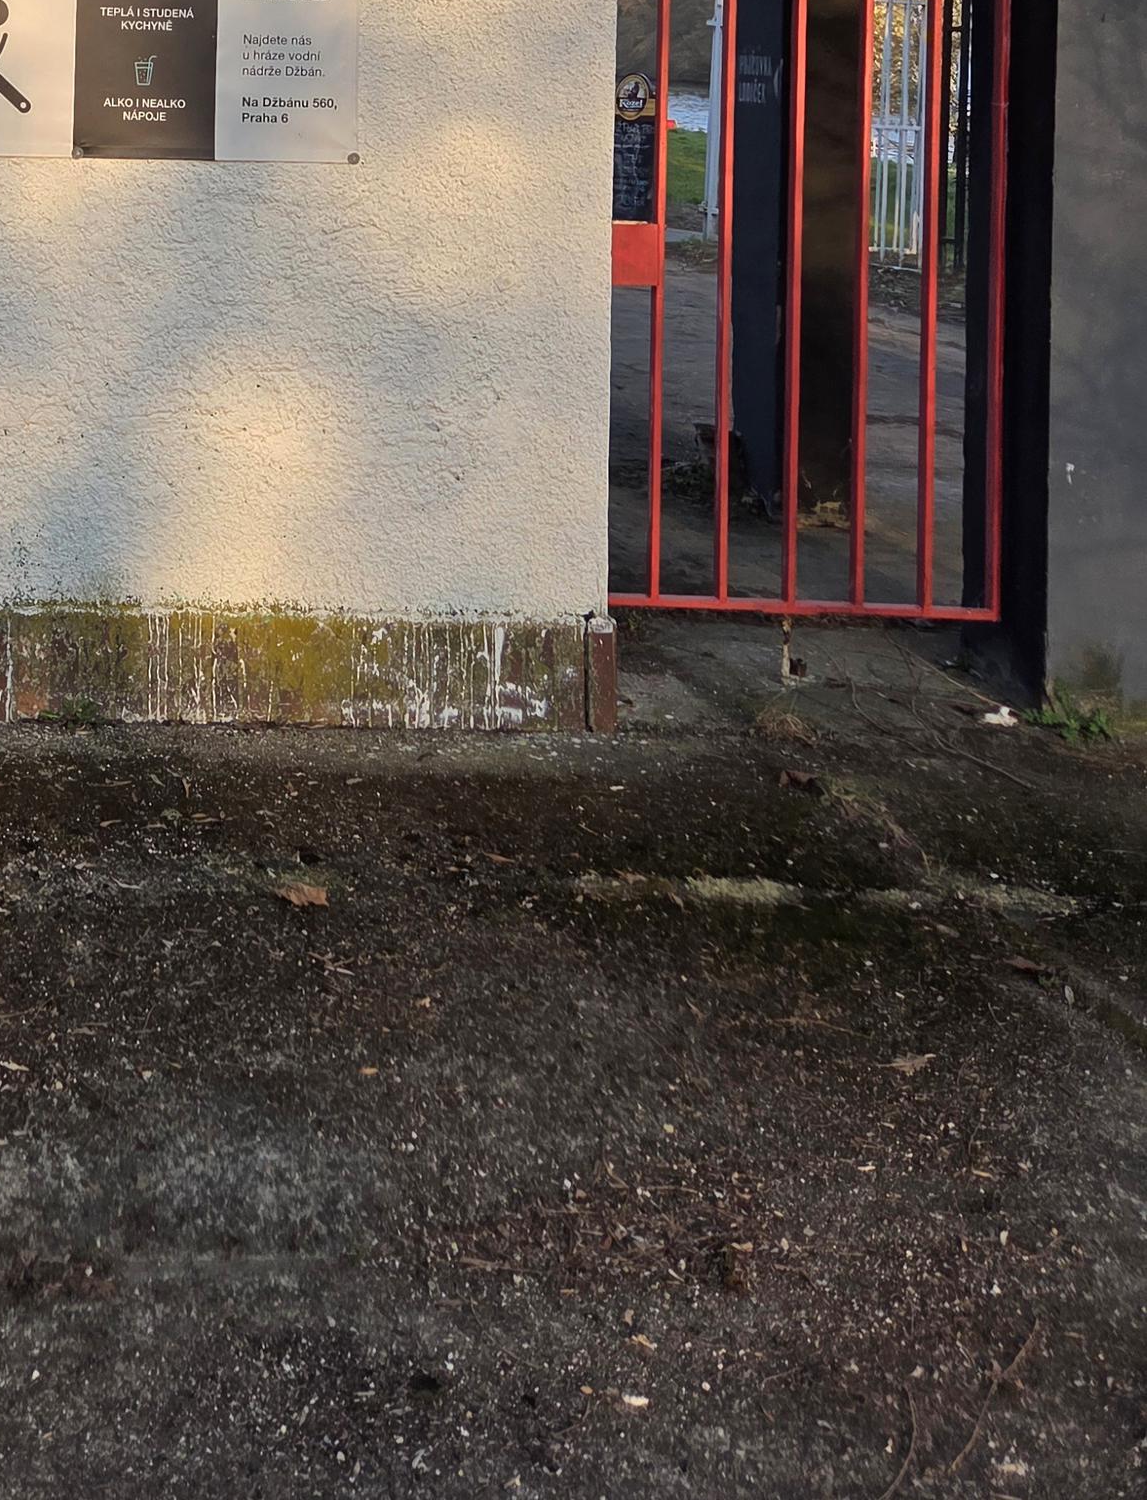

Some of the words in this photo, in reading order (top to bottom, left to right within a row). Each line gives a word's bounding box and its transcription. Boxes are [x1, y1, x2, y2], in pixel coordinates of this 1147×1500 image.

[99, 5, 135, 17] TEPLÁ
[142, 7, 195, 19] STUDENÁ
[243, 34, 288, 47] Najdete
[291, 35, 312, 46] nás
[242, 52, 250, 60] u
[253, 50, 285, 61] hráze
[288, 50, 321, 61] vodní
[242, 65, 282, 76] nádrže
[285, 65, 326, 77] Džbán.
[103, 97, 133, 108] ALKO
[142, 98, 186, 109] NEALKO
[241, 96, 259, 108] Na
[262, 97, 309, 108] Džbánu
[312, 98, 338, 110] 560,
[122, 109, 167, 122] NÁPOJE
[241, 112, 278, 123] Praha
[281, 113, 289, 123] 6
